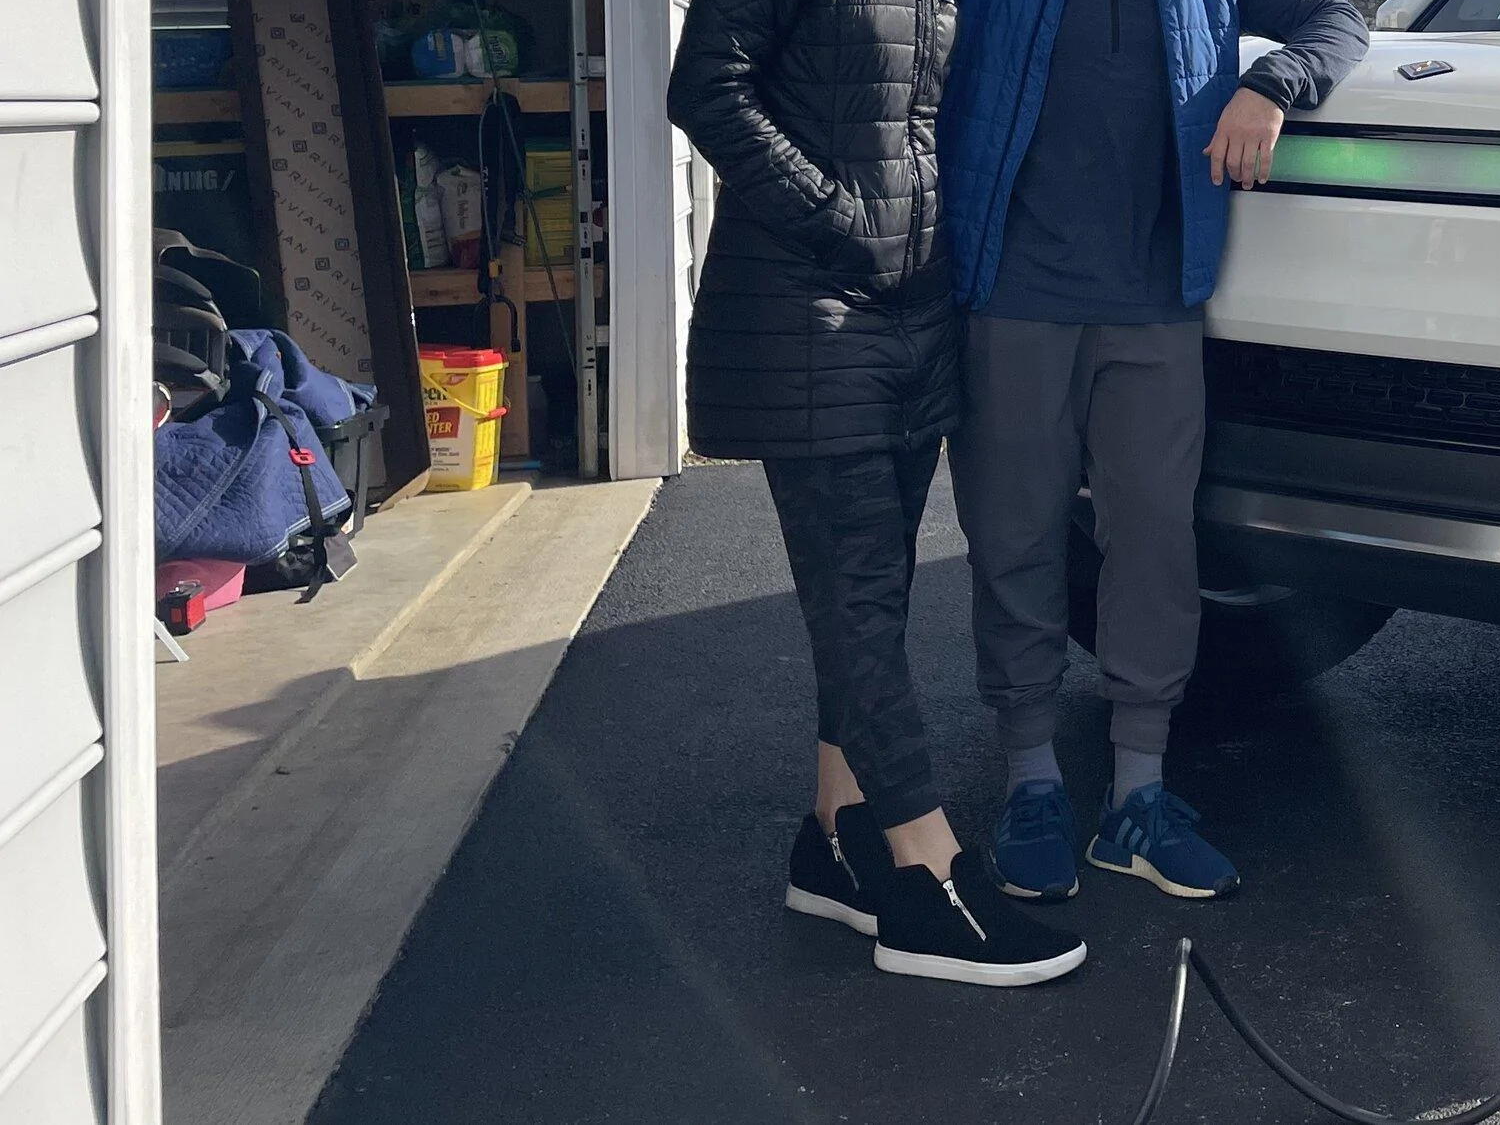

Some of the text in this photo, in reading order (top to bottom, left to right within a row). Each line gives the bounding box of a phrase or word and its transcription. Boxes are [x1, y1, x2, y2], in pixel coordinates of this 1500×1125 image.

[260, 82, 305, 118] VIAN
[266, 56, 325, 101] RIVIAN
[289, 170, 347, 216] RIVIAN
[290, 309, 351, 356] RIVIAN
[311, 289, 368, 335] RIVIAN
